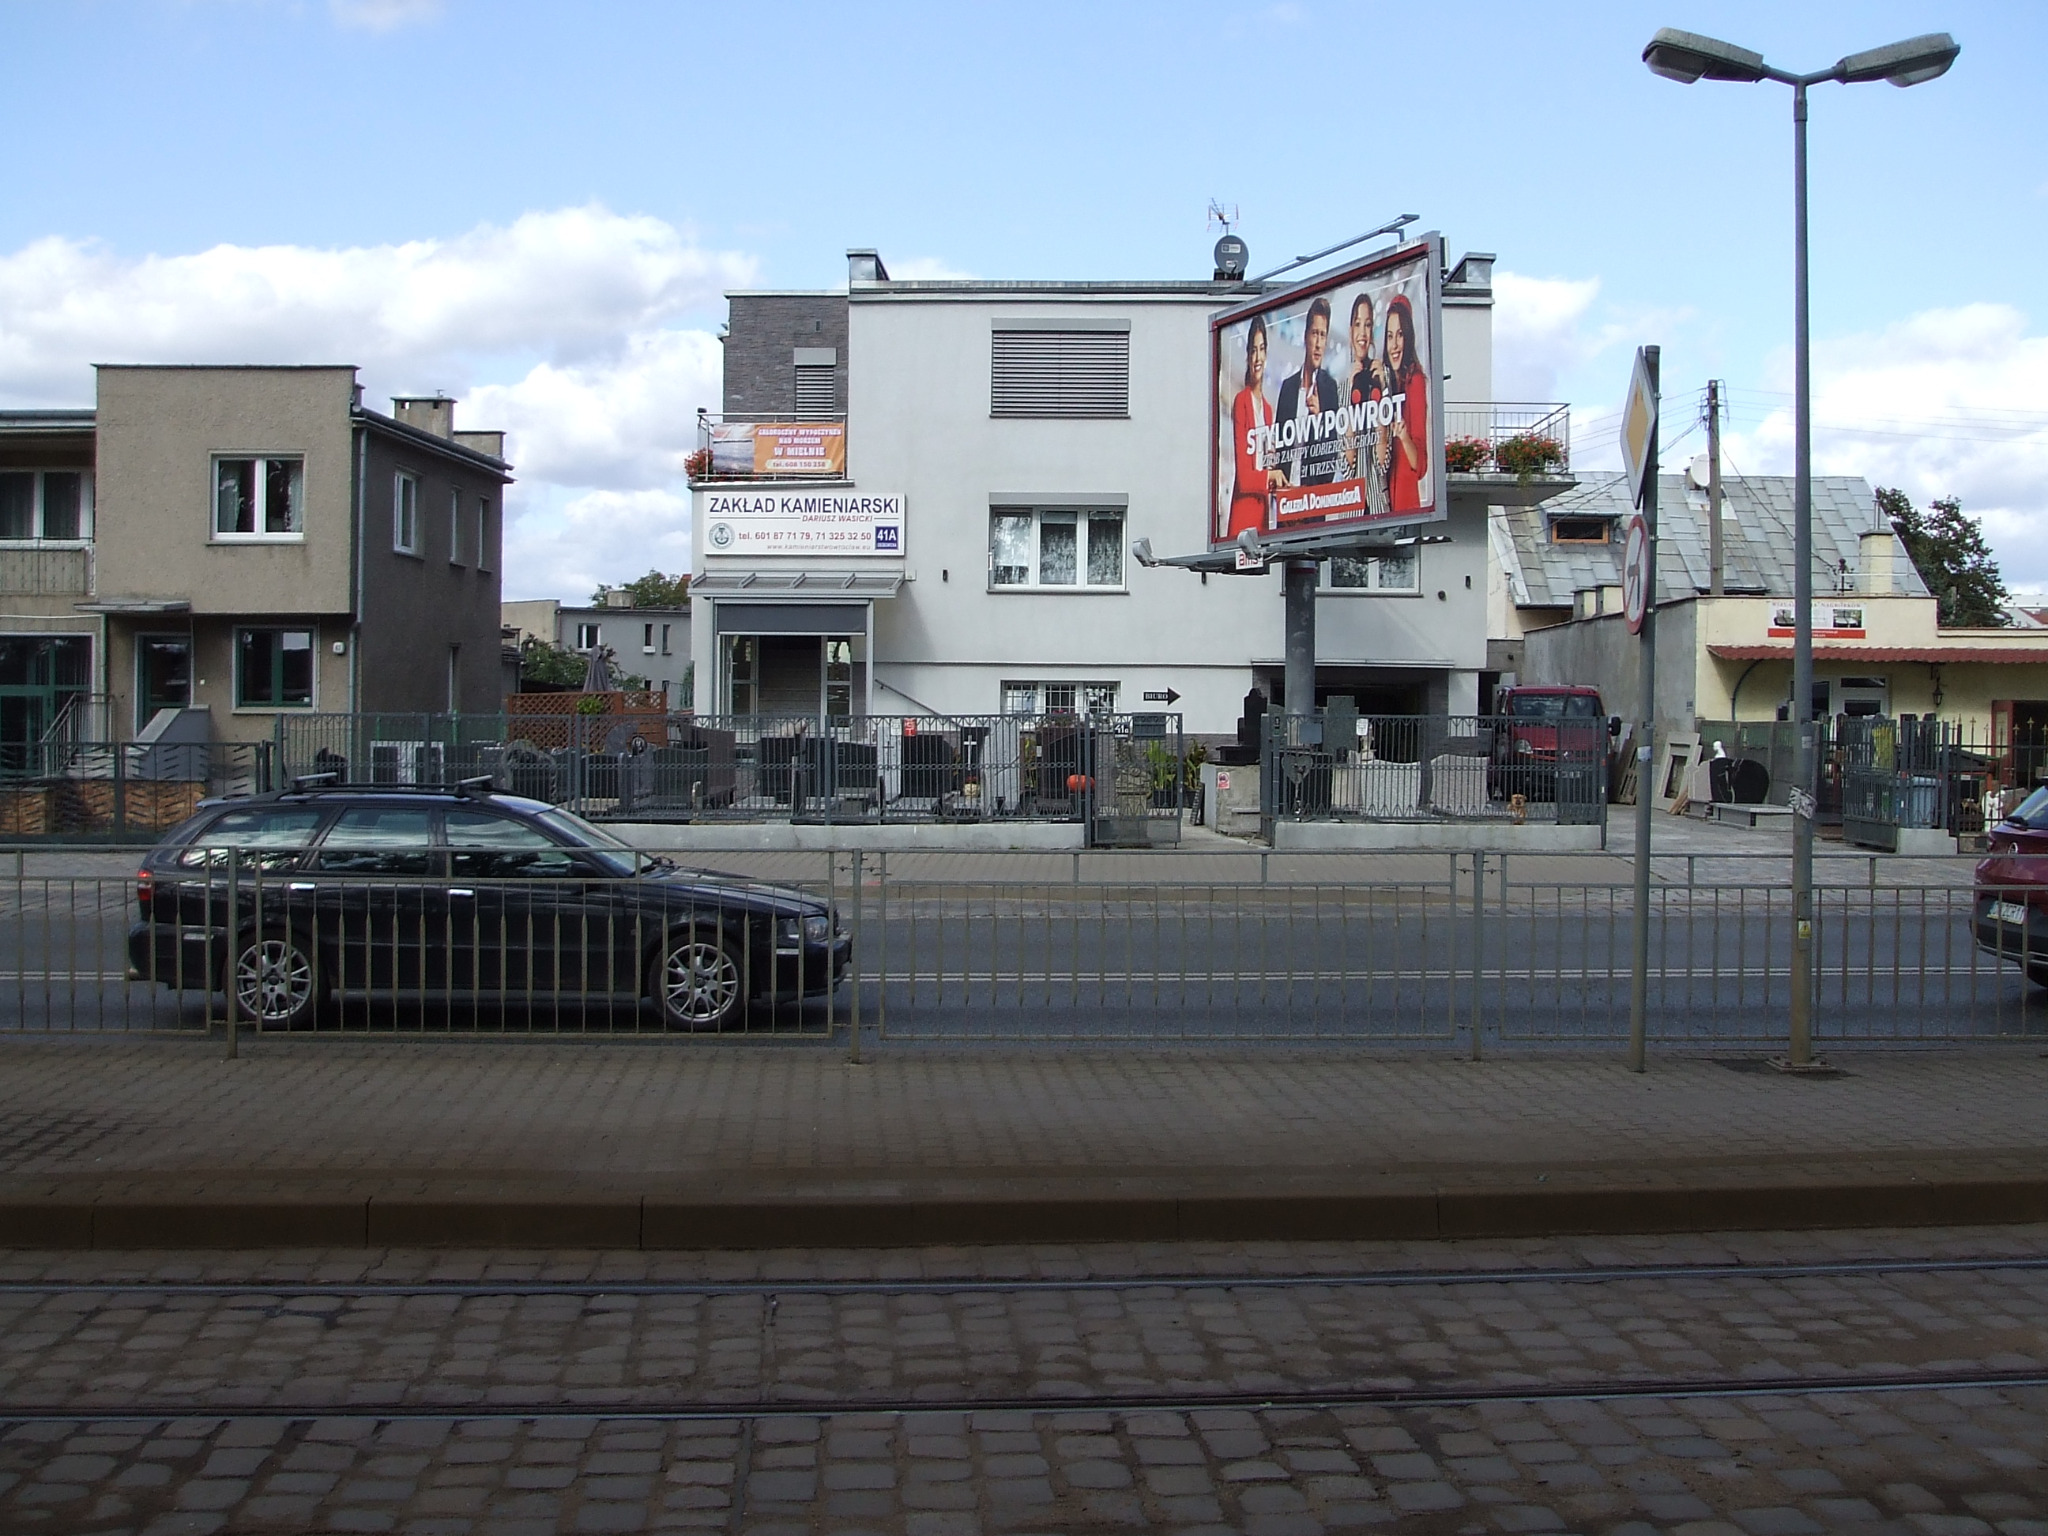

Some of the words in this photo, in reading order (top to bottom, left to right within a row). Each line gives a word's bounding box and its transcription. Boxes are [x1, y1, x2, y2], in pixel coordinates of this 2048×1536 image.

[1246, 412, 1322, 455] STYLOWY
[1324, 388, 1406, 439] POWRÓT
[774, 447, 784, 456] W
[786, 447, 825, 456] MIELNIE
[709, 497, 776, 513] ZAKŁAD
[781, 498, 899, 513] KAMIENIARSKI
[839, 515, 873, 523] WASICKI
[738, 532, 752, 540] tel.
[755, 532, 770, 540] 601
[773, 532, 784, 540] 87
[787, 532, 796, 540] 71
[800, 532, 814, 541] 79,
[816, 532, 826, 540] 71
[829, 532, 845, 540] 325
[848, 532, 858, 540] 32
[860, 532, 872, 540] 50
[877, 529, 897, 541] 41A
